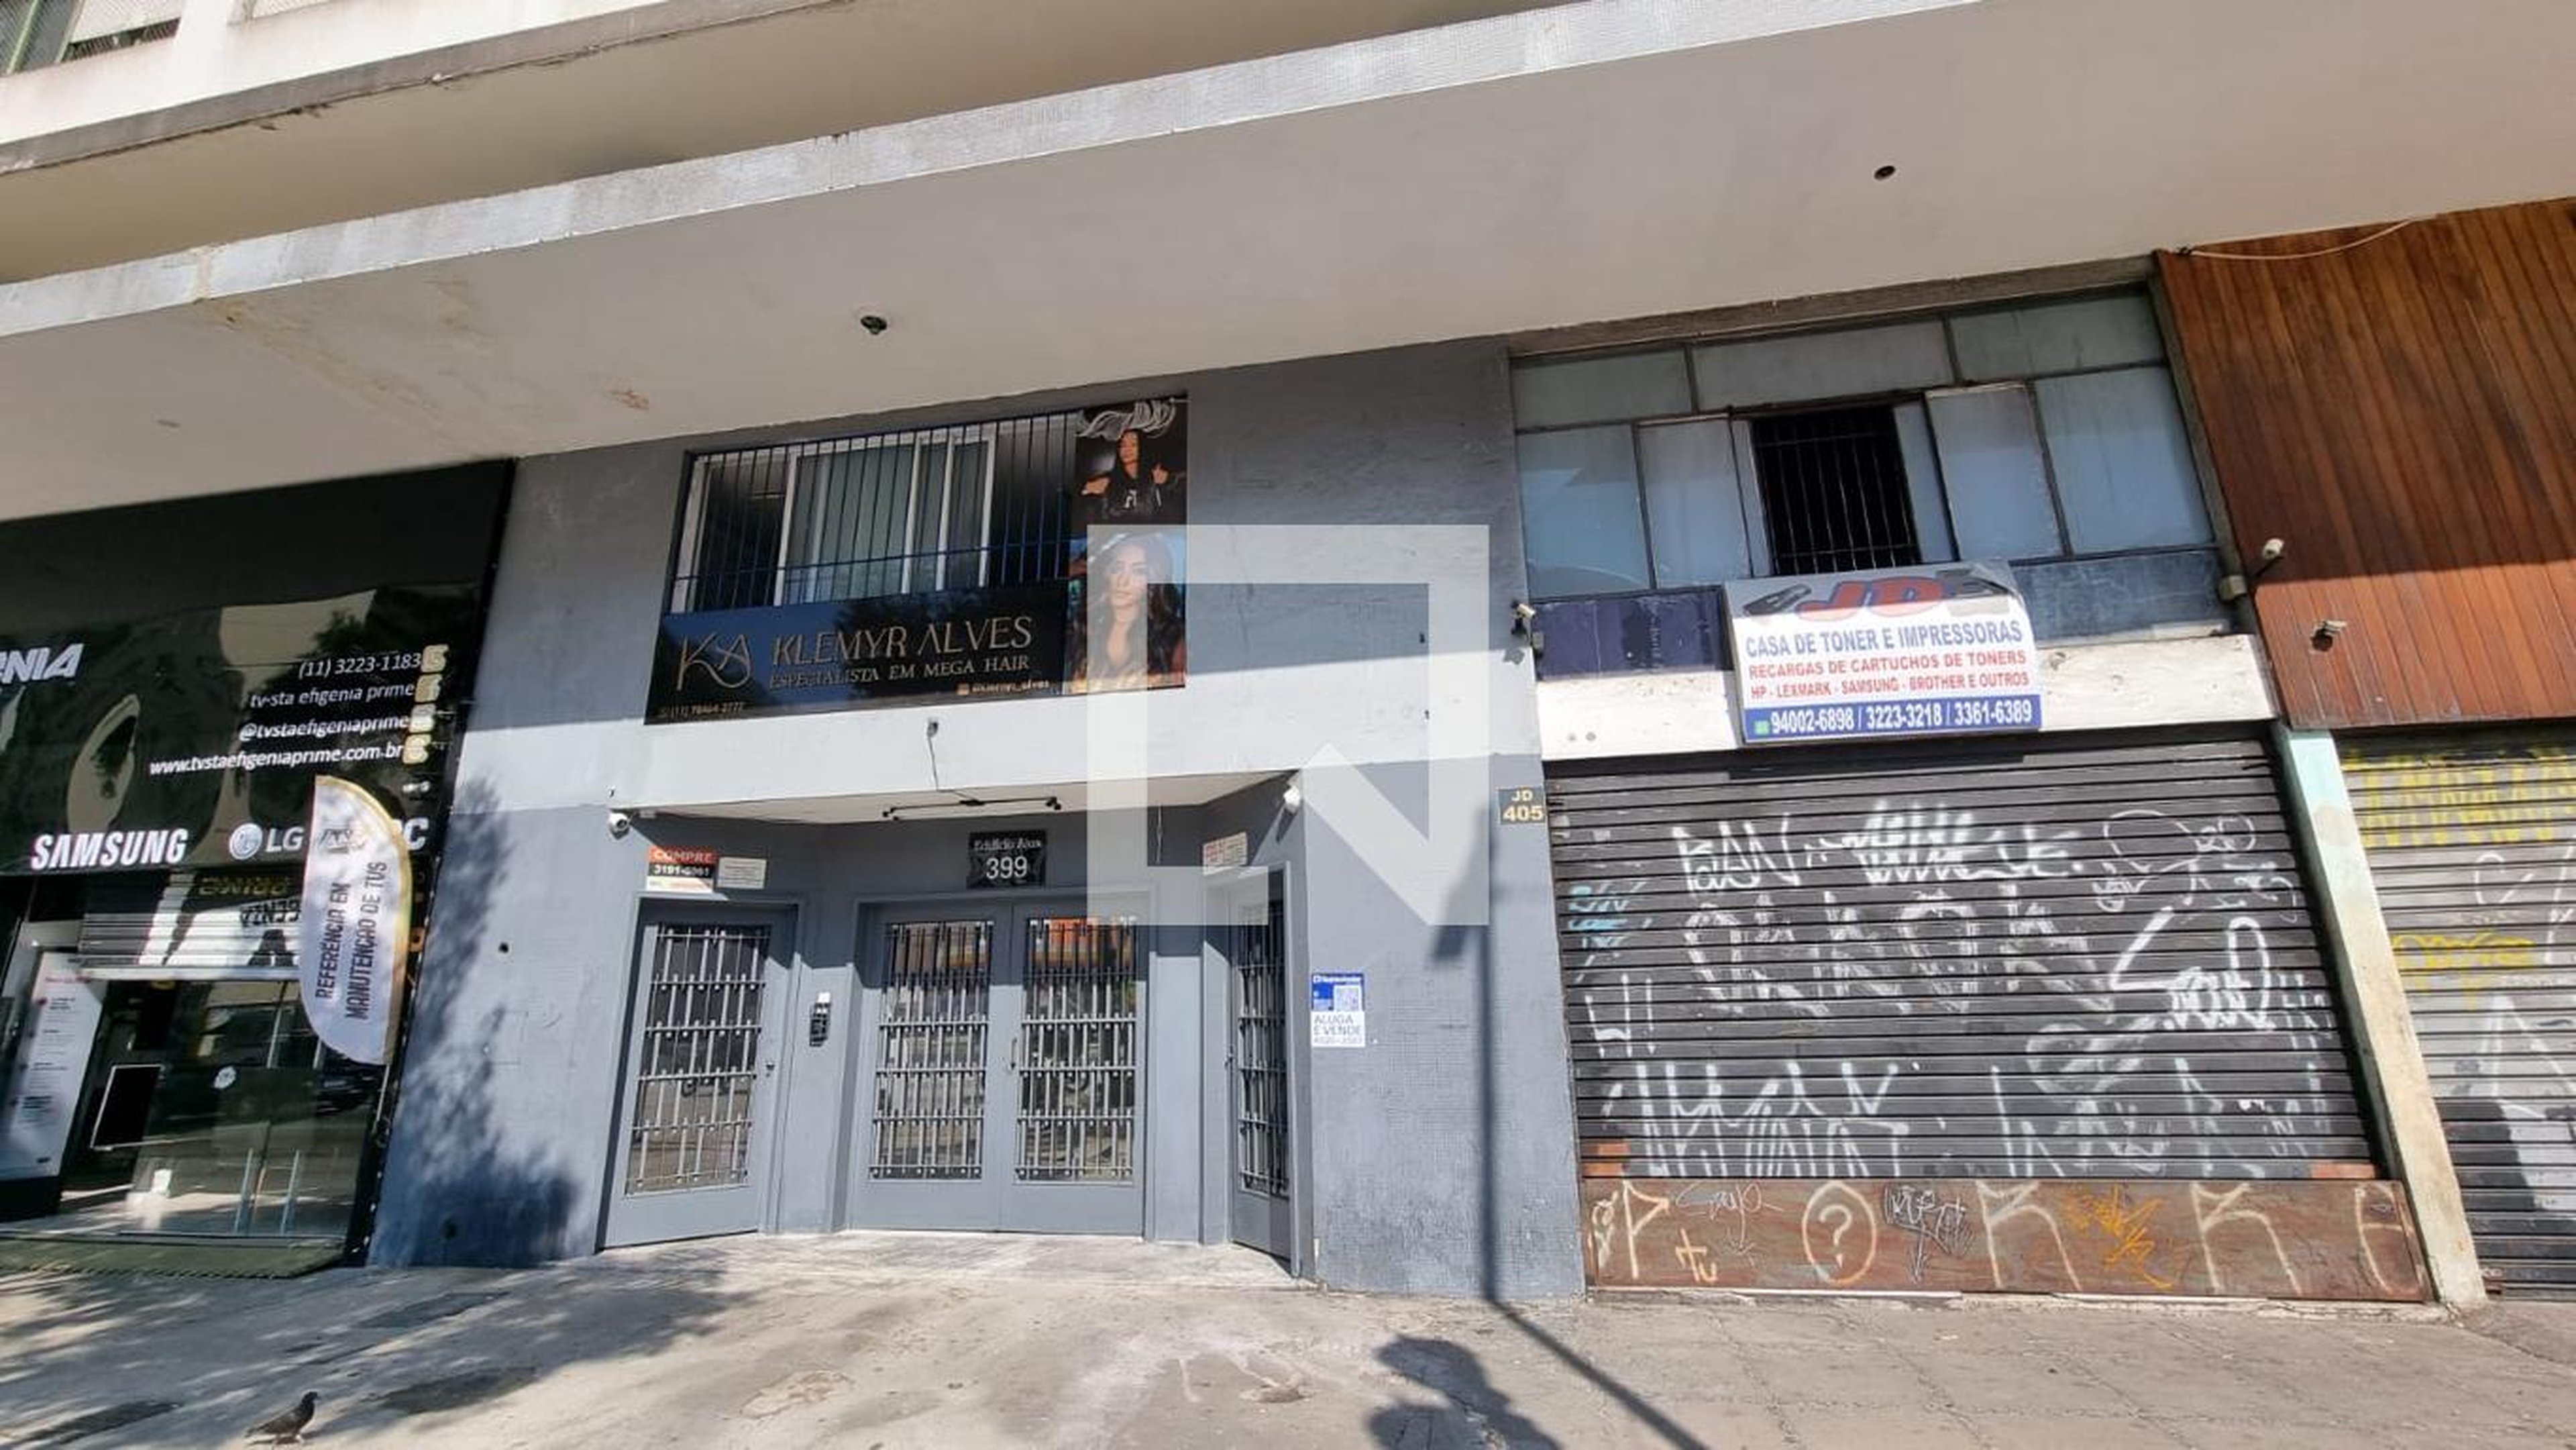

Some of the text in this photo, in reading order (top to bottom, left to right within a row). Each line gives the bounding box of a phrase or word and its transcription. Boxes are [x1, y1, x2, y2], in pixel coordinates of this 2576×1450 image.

[1794, 576, 1945, 622] JD
[773, 616, 1032, 666] KLEMYR ALVES
[1746, 620, 2023, 658] CASA DE TONER E IMPRESSORAS
[0, 643, 85, 684] NIA
[299, 653, 422, 679] (11) 3223-1183
[770, 654, 1030, 690] ESPECIALISTA EM MEGA HAIR
[1749, 650, 2027, 680] RECARGAS DE CARTUCHOS DE TONERS
[366, 682, 415, 703] prime
[1751, 685, 1768, 700] HP
[1777, 681, 1832, 698] LEXMARK
[1841, 676, 1899, 695] SAMSUNG
[1909, 674, 1966, 691] BROTHER
[1968, 673, 1977, 688] E
[1979, 672, 2030, 688] OUTROS
[239, 715, 411, 741] @tvstaefigeniaprime
[1770, 707, 1854, 735] 94002-6898
[1866, 702, 1943, 729] 3223-3218
[1954, 698, 2033, 725] 3361-6389
[150, 743, 405, 776] www.tvstaefigeniaprime.com.br
[1511, 789, 1534, 802] JD
[1503, 805, 1544, 822] 405
[30, 827, 189, 870] SAMSUNG
[266, 825, 305, 853] LG
[985, 856, 1028, 880] 399
[329, 882, 352, 904] EM
[360, 894, 381, 914] DE
